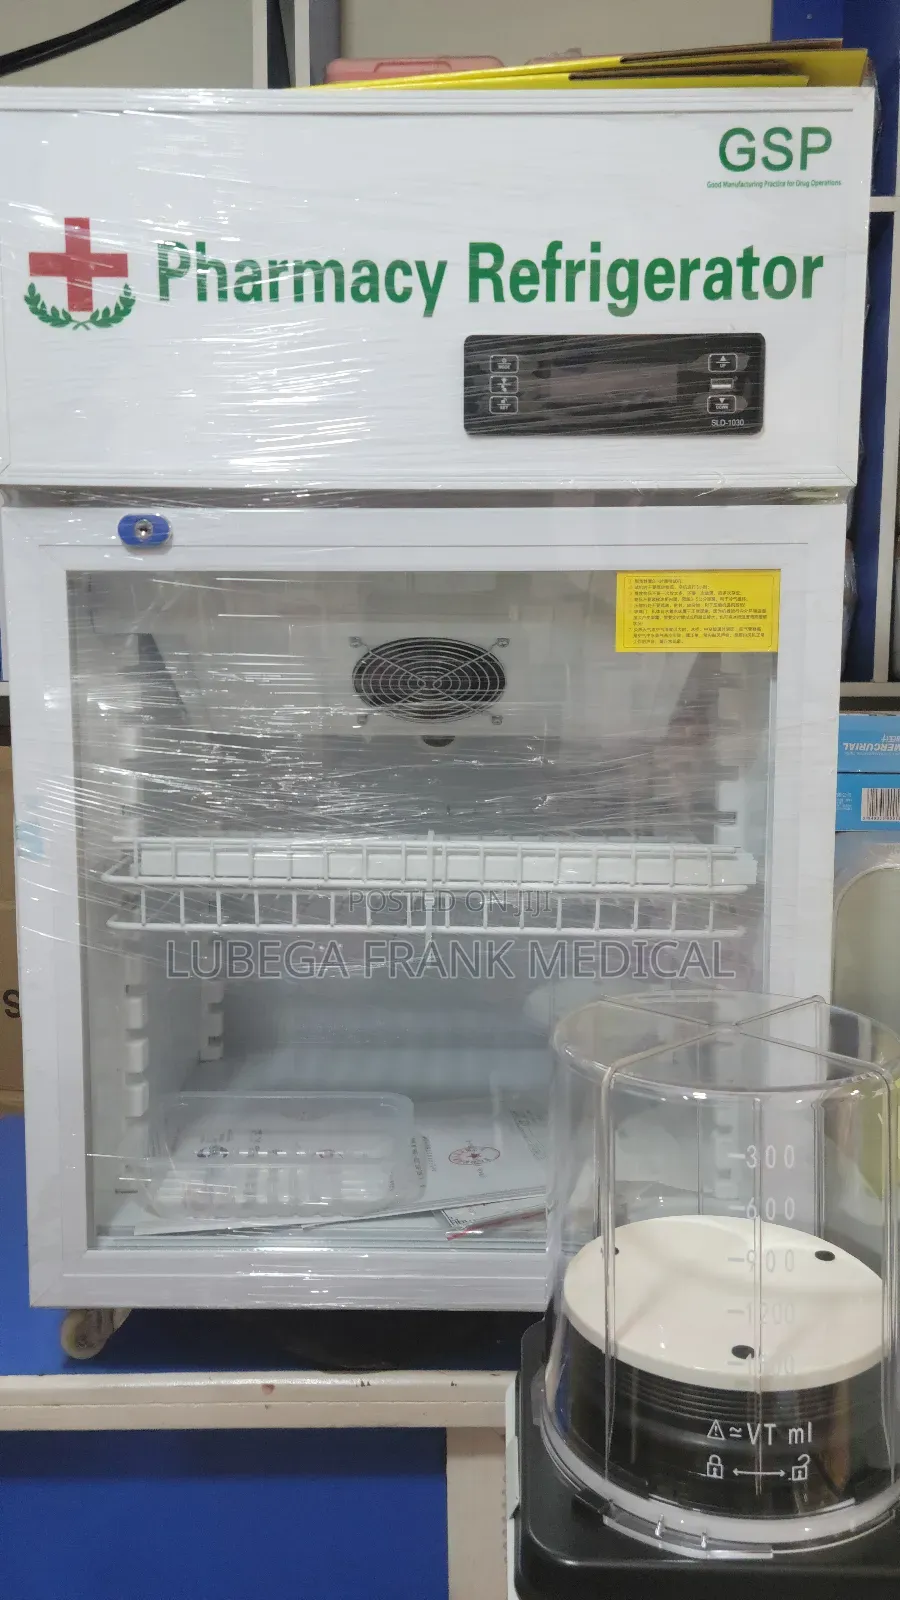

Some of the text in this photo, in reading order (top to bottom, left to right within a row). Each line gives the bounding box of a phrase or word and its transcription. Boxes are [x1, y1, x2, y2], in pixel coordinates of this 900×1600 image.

[719, 127, 832, 172] GSP
[707, 181, 721, 189] Good
[723, 181, 763, 189] Manufacturing
[764, 180, 786, 188] Practice
[796, 180, 810, 188] Drug
[811, 179, 842, 187] Operations
[158, 240, 824, 317] Pharmacy Refrigerator
[711, 418, 745, 427] SLD-1030
[788, 1421, 813, 1445] ml
